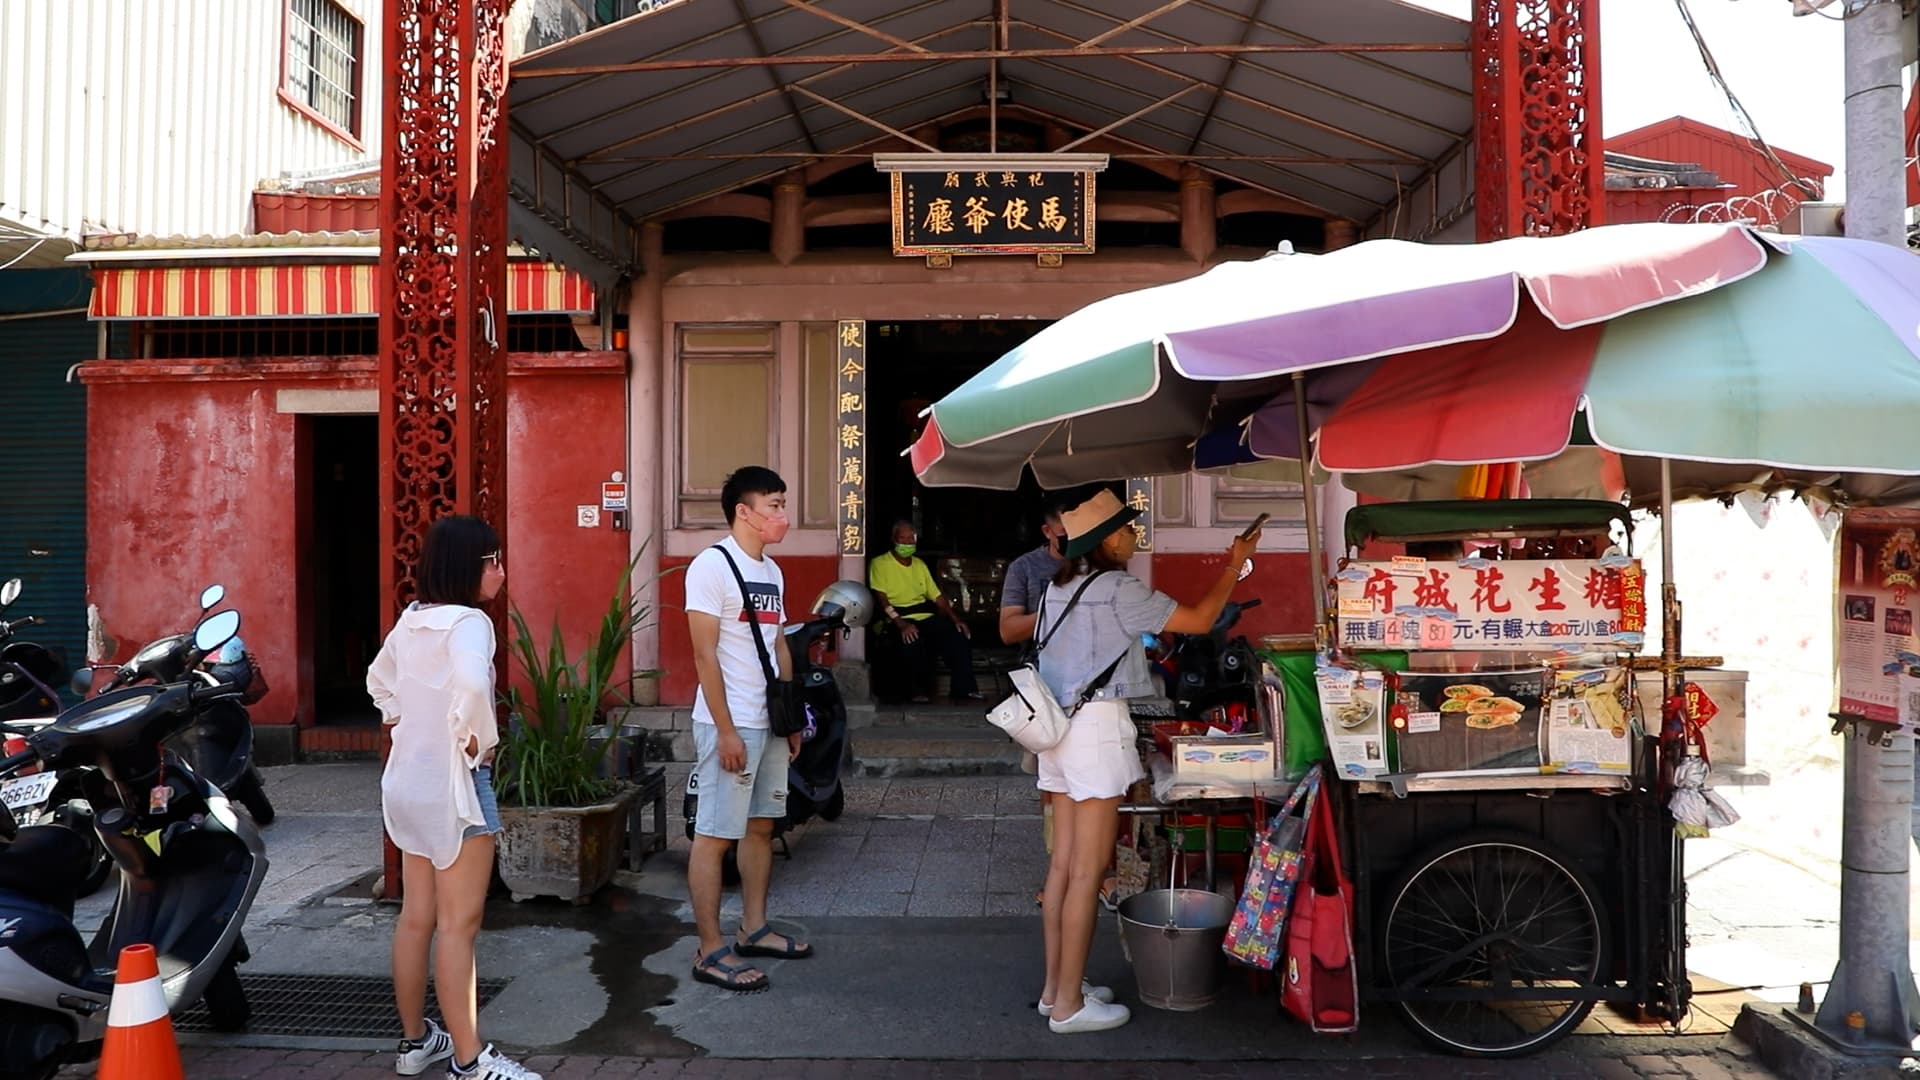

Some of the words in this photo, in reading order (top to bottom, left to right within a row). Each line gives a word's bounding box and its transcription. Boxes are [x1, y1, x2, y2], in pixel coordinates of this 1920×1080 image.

[1362, 567, 1622, 614] 府城花生糖
